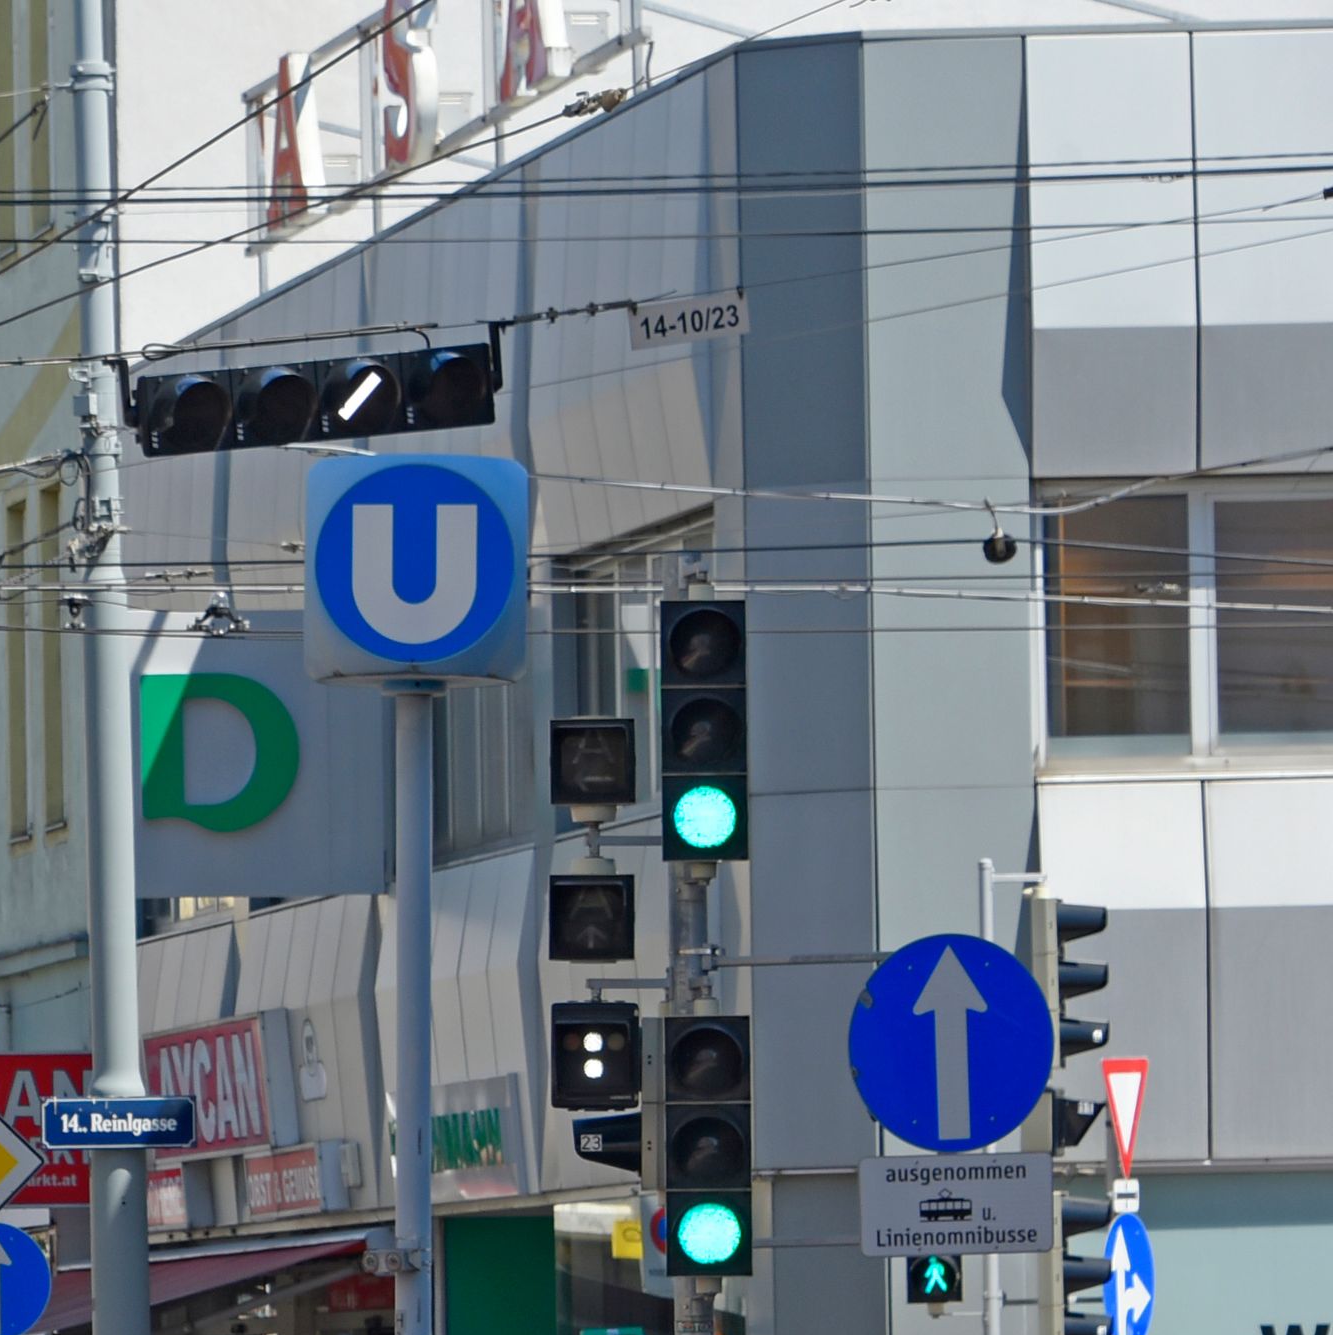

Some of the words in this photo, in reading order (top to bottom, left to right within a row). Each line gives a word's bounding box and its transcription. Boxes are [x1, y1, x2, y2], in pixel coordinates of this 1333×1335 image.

[640, 305, 740, 340] 14-10/23
[352, 504, 478, 645] U
[140, 672, 301, 833] D
[158, 1030, 262, 1144] AYCAN
[90, 1112, 178, 1137] Reinlgasse
[581, 1135, 601, 1151] 23
[886, 1164, 1027, 1185] ausgenommen
[982, 1207, 997, 1221] u.
[876, 1226, 1038, 1248] Linienomnibusse
